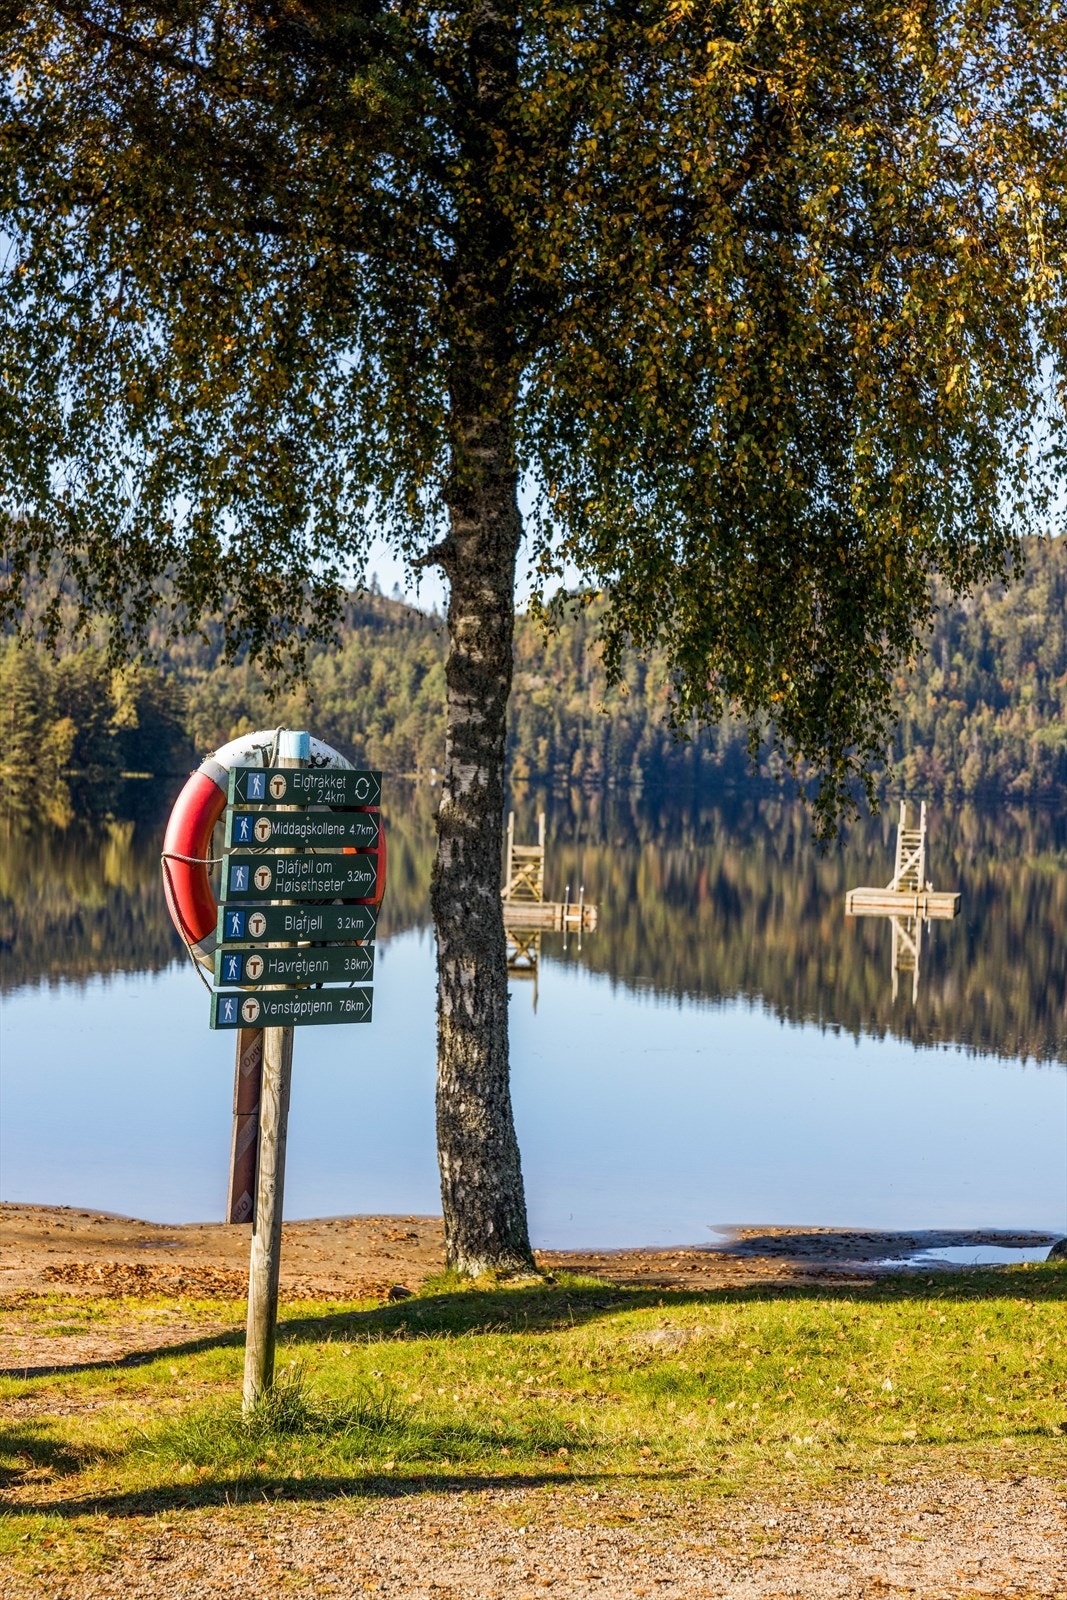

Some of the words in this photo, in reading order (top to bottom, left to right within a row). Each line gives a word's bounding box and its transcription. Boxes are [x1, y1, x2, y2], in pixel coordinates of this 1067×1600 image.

[316, 789, 346, 803] 2.4km
[271, 821, 345, 838] Middagskollene
[349, 823, 374, 836] 4.7km
[315, 862, 333, 874] om
[346, 870, 372, 883] 3.2km
[275, 876, 345, 893] Høisethseter
[336, 917, 364, 930] 3.2km
[268, 958, 329, 976] Havretjenn
[343, 958, 369, 972] 3.8km
[262, 1000, 333, 1017] Venstøptjenn
[339, 1000, 364, 1013] 7.6km
